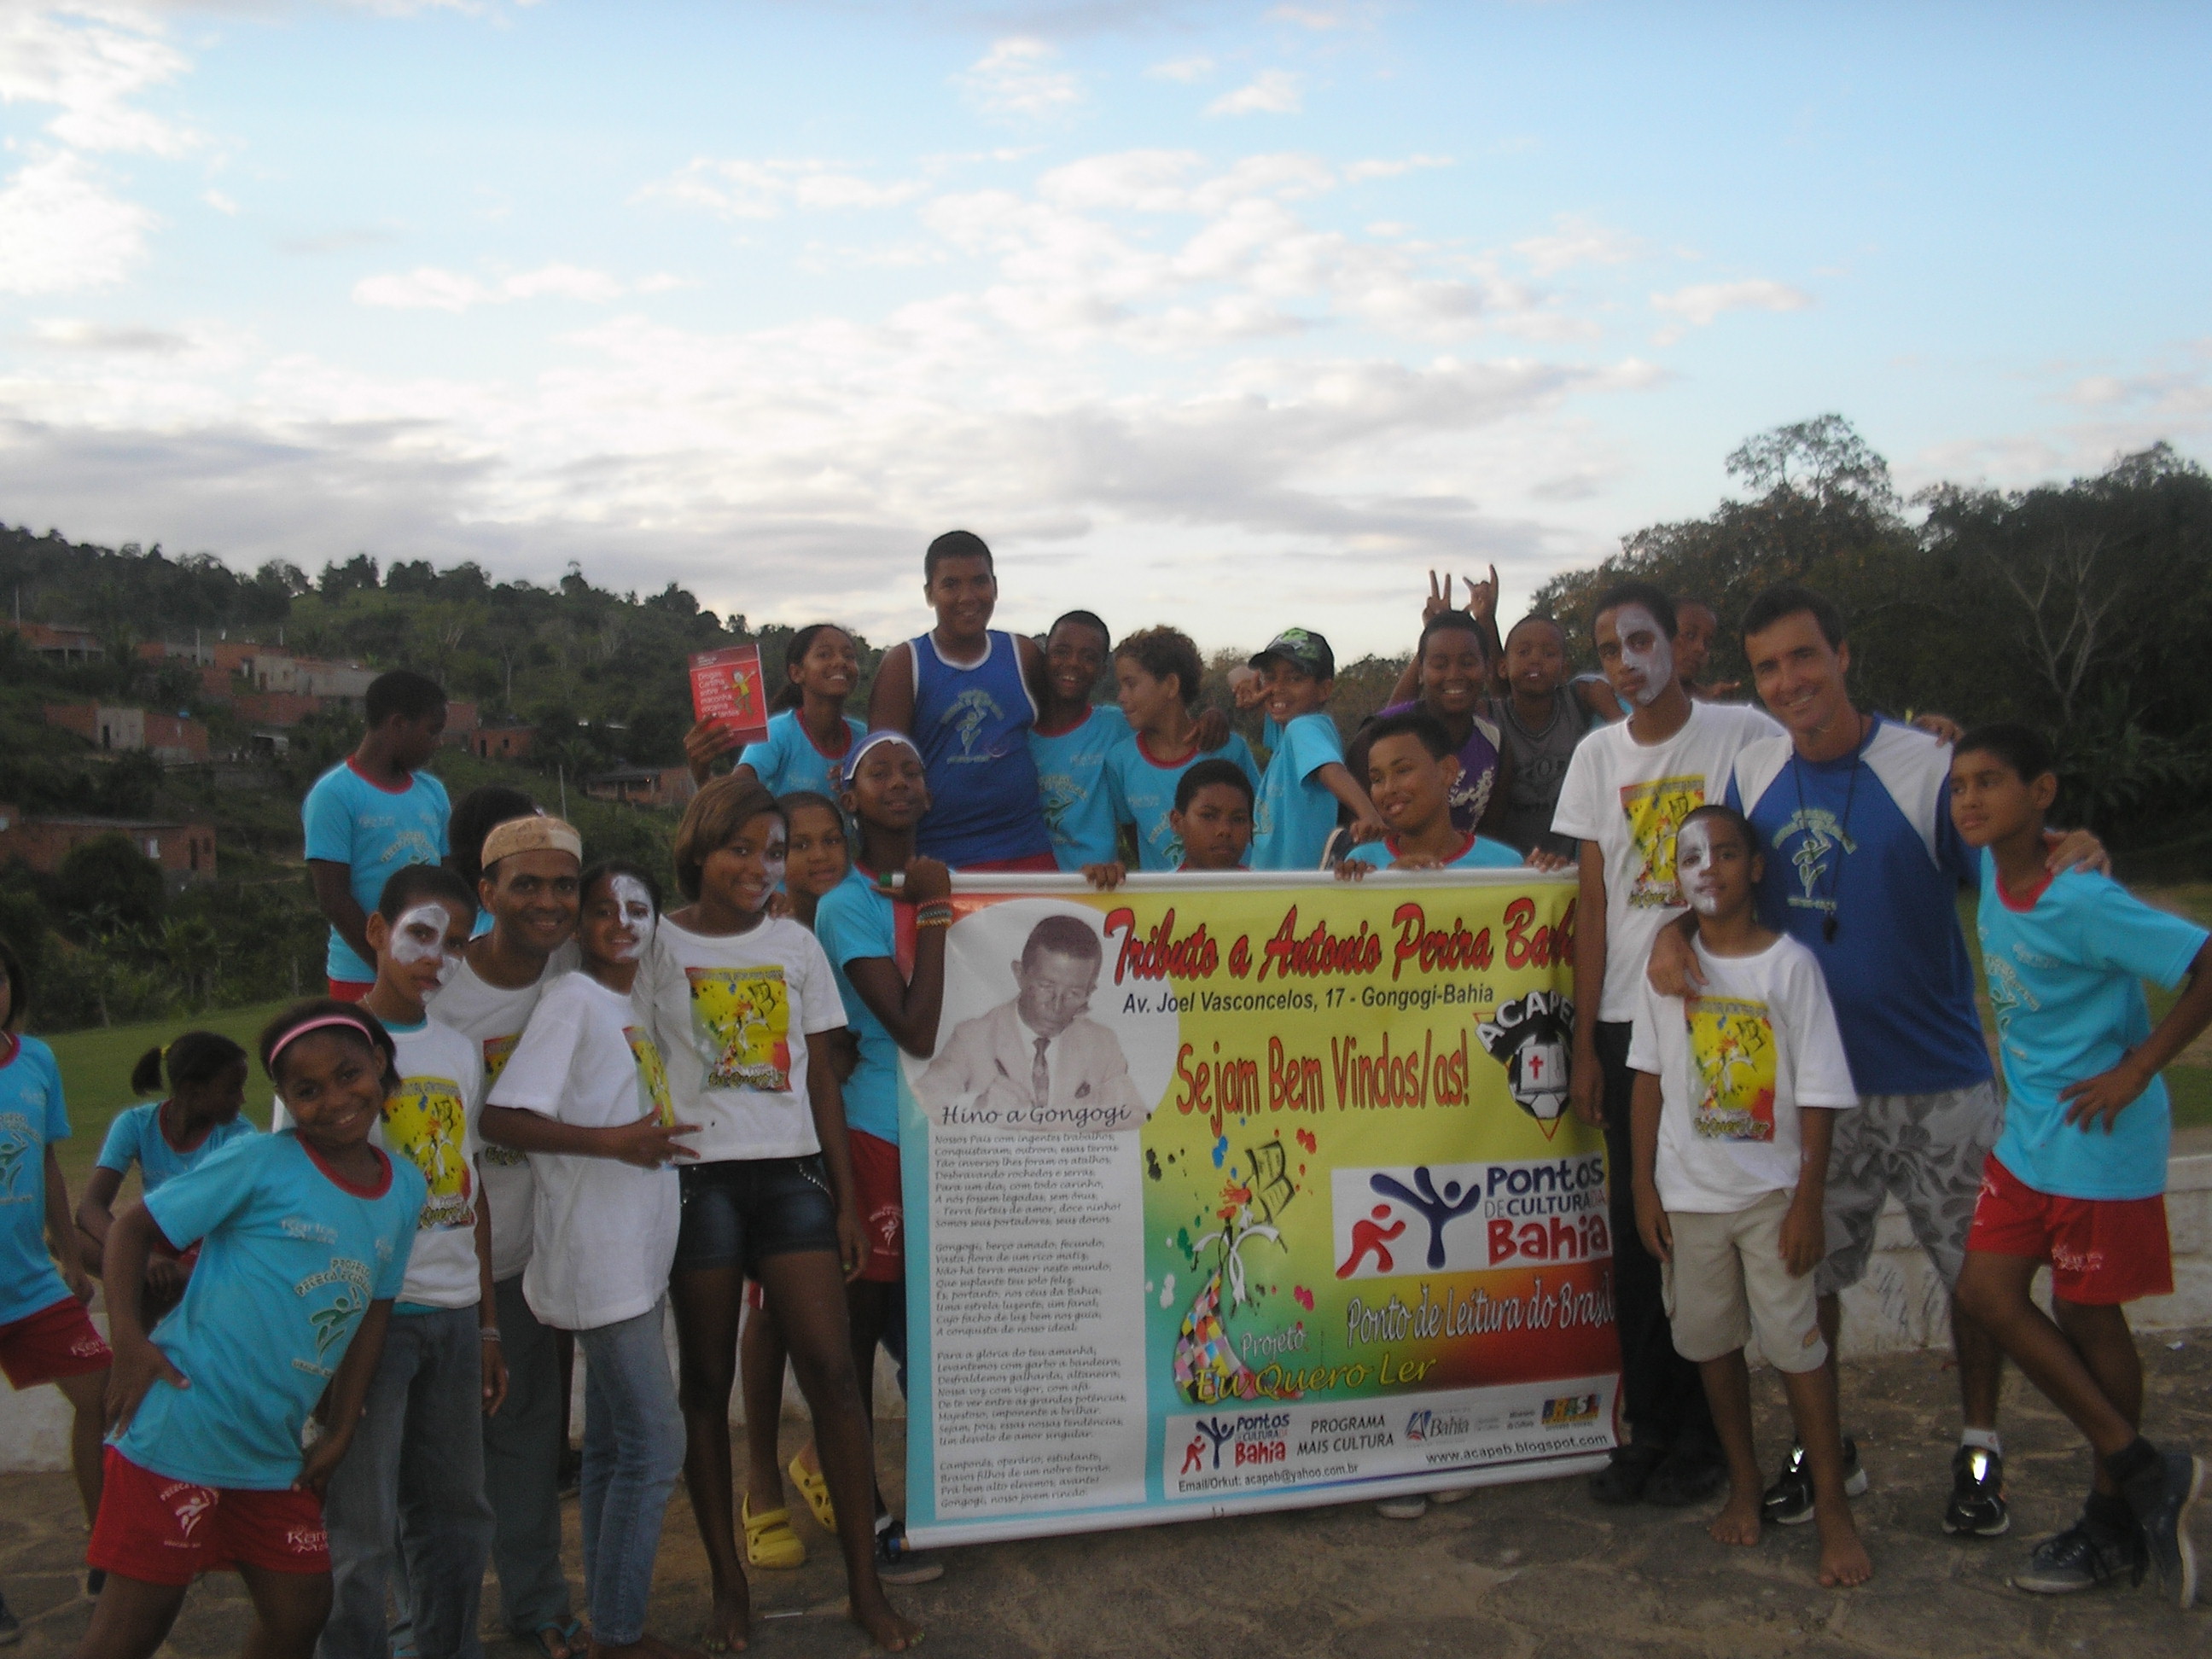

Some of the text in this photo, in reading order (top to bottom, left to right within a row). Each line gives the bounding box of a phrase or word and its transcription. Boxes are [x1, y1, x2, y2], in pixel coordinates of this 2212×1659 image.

[1103, 906, 1219, 987] Tributo
[1229, 934, 1252, 981] a
[1257, 904, 1382, 983] Antonio
[1122, 992, 1150, 1014] Av.
[1156, 992, 1195, 1013] Joel
[1201, 988, 1317, 1013] Vasconcelos,
[1325, 987, 1345, 1008] 17
[1361, 983, 1493, 1011] Gongogi-Bahia
[1177, 1028, 1470, 1138] Sejam Bem Vindos/as!
[942, 1105, 1132, 1128] Hino a Gongogi
[935, 1136, 967, 1144] Nossos
[970, 1135, 991, 1144] Pais
[1018, 1134, 1060, 1144] ingentes
[937, 1157, 955, 1167] Tão
[1002, 1155, 1023, 1166] lhes
[1025, 1157, 1057, 1167] foram
[936, 1169, 1004, 1180] Desbravando
[1008, 1169, 1053, 1179] rochedos
[1487, 1158, 1605, 1197] Pontos
[936, 1182, 960, 1191] Para
[1033, 1180, 1057, 1189] todo
[935, 1195, 941, 1203] A
[946, 1193, 963, 1203] nós
[966, 1193, 1000, 1204] fossem
[944, 1207, 970, 1215] Terra
[1010, 1204, 1022, 1213] de
[1059, 1202, 1083, 1211] doce
[935, 1219, 968, 1227] Somos
[970, 1218, 991, 1226] seus
[986, 1242, 1014, 1251] berço
[1487, 1214, 1610, 1268] Bahia
[936, 1254, 964, 1264] Vasta
[968, 1253, 993, 1264] flora
[996, 1252, 1008, 1261] de
[1032, 1253, 1052, 1261] rico
[936, 1266, 957, 1276] Não
[960, 1266, 973, 1274] há
[977, 1266, 1004, 1274] terra
[1007, 1266, 1039, 1274] maior
[1043, 1264, 1068, 1272] neste
[936, 1279, 957, 1289] Que
[960, 1278, 1004, 1289] suplante
[1007, 1278, 1024, 1286] teu
[1027, 1276, 1047, 1285] solo
[1025, 1288, 1046, 1297] céus
[1050, 1287, 1063, 1296] da
[964, 1301, 998, 1310] estrela
[1048, 1299, 1064, 1307] um
[936, 1314, 958, 1326] Cujo
[962, 1313, 991, 1324] facho
[994, 1312, 1007, 1322] de
[1010, 1312, 1026, 1324] luz
[1030, 1312, 1051, 1321] bem
[1347, 1295, 1412, 1349] Ponto
[1413, 1282, 1444, 1340] de
[1445, 1286, 1523, 1339] Leitura
[1526, 1277, 1557, 1330] do
[936, 1327, 943, 1336] A
[946, 1326, 998, 1338] conquista
[1000, 1324, 1014, 1334] de
[1240, 1324, 1307, 1367] Projeto
[1196, 1351, 1437, 1406] Eu Quero Ler
[1236, 1413, 1290, 1433] Pontos
[1311, 1414, 1386, 1435] PROGRAMA
[1429, 1415, 1470, 1438] Bahia
[1295, 1438, 1329, 1458] MAIS
[1332, 1433, 1394, 1453] CULTURA
[1235, 1441, 1286, 1469] Bahia
